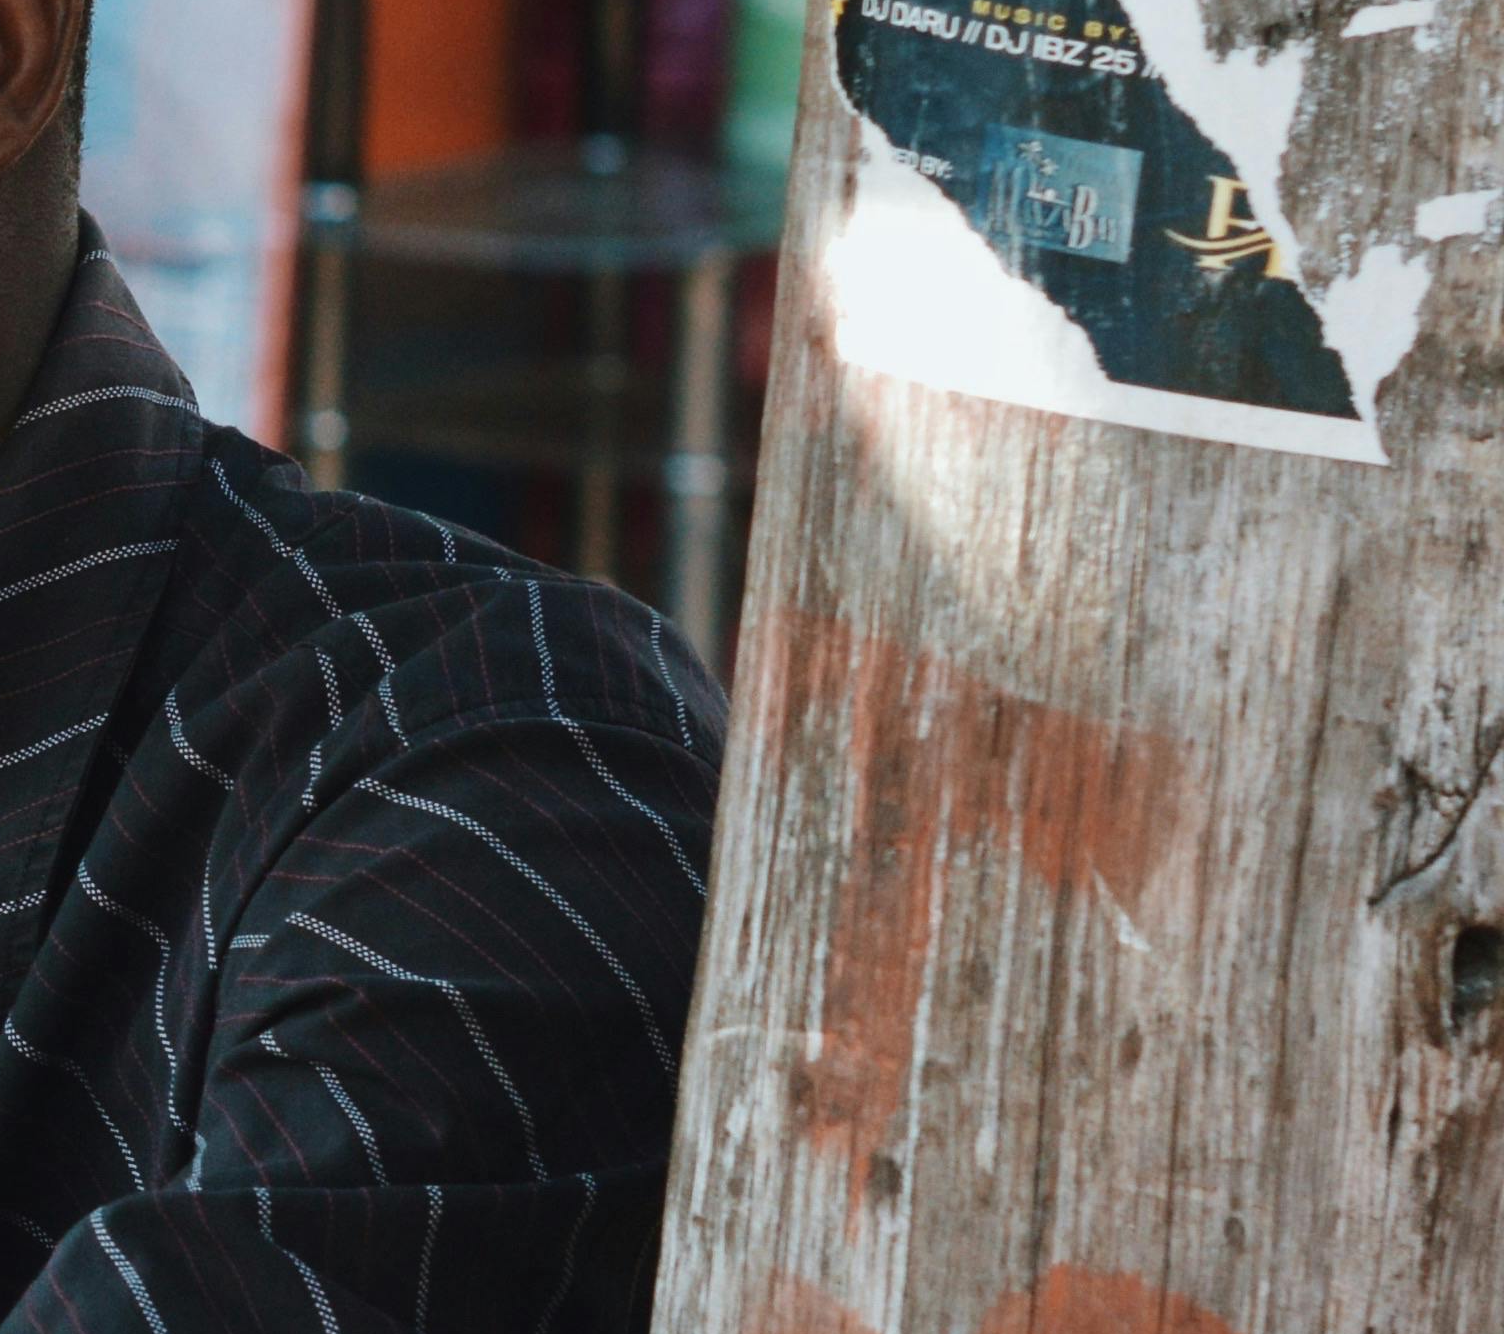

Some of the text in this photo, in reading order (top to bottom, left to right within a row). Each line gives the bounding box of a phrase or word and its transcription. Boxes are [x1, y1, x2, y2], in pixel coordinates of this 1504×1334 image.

[890, 1, 963, 40] DARU
[985, 25, 1030, 56] DJ
[1033, 34, 1089, 66] IBZ
[1089, 45, 1138, 76] 25
